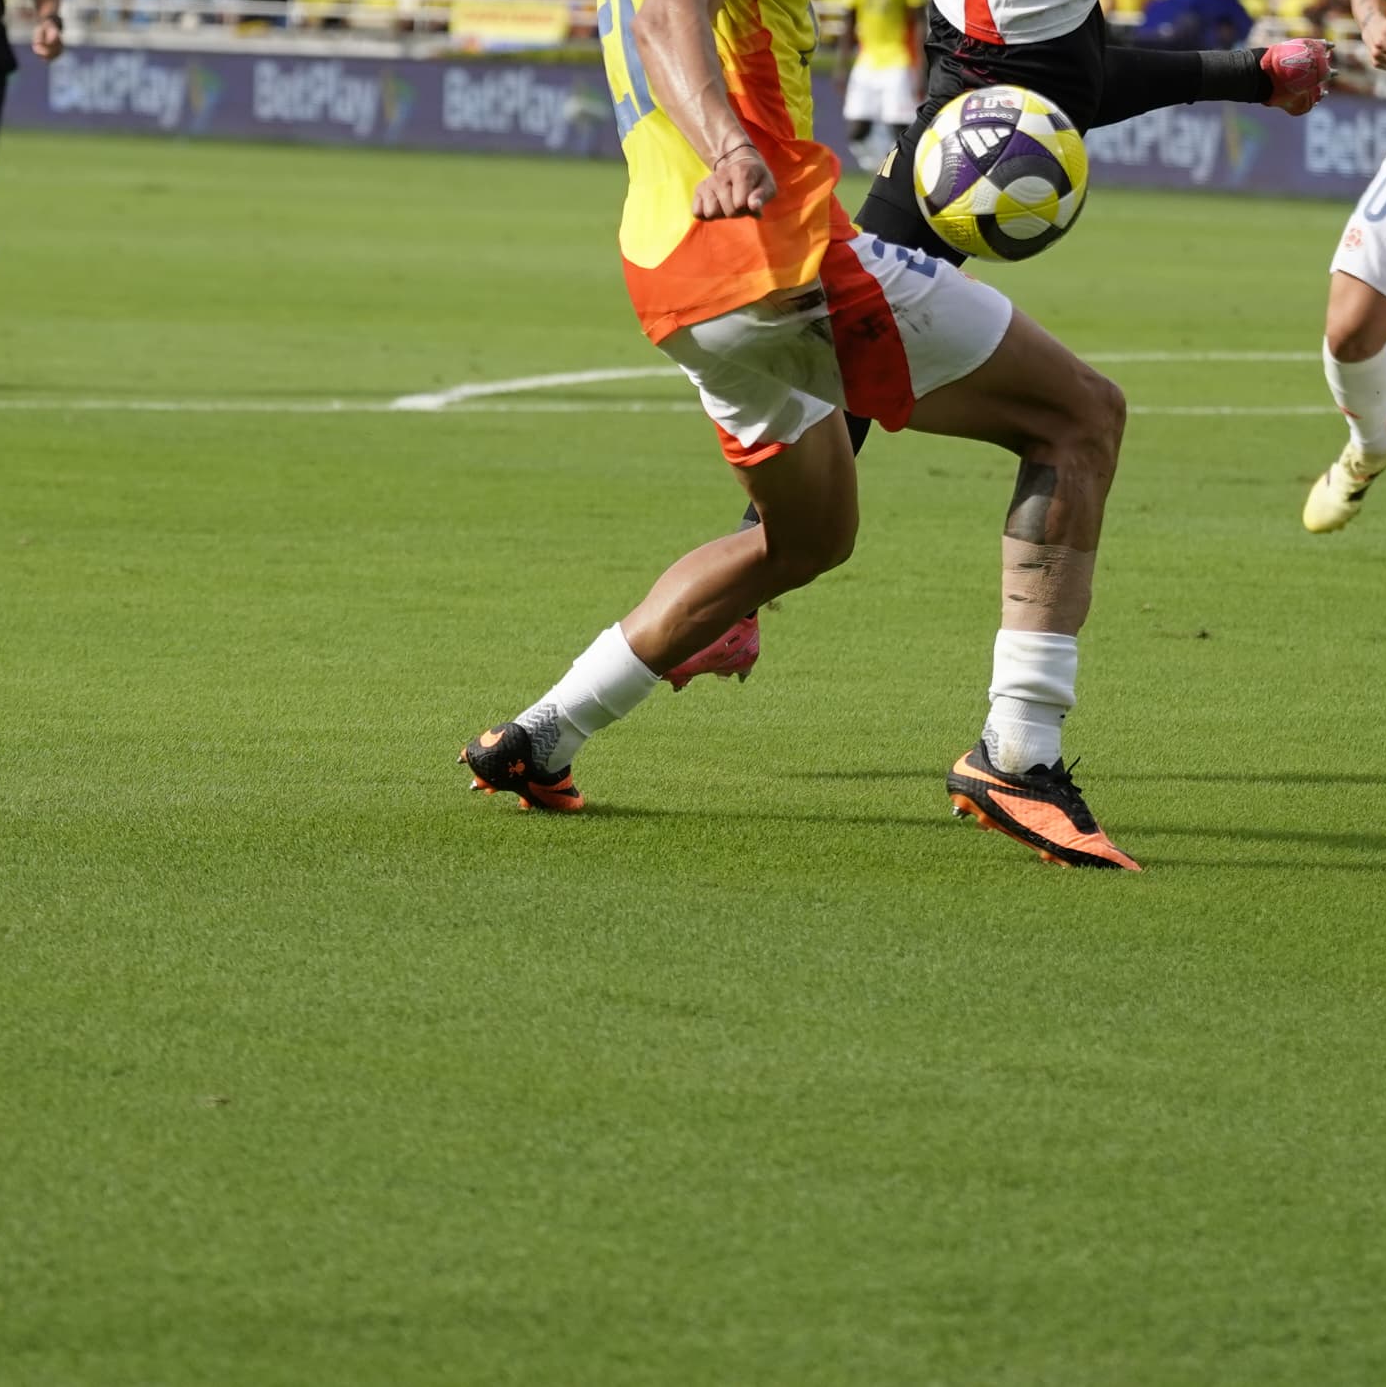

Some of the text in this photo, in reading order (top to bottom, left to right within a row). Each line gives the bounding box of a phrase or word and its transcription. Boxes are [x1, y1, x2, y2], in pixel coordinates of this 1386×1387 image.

[48, 51, 187, 130] BetPlay
[253, 57, 380, 138] BetPlay
[442, 66, 571, 149] BetPlay
